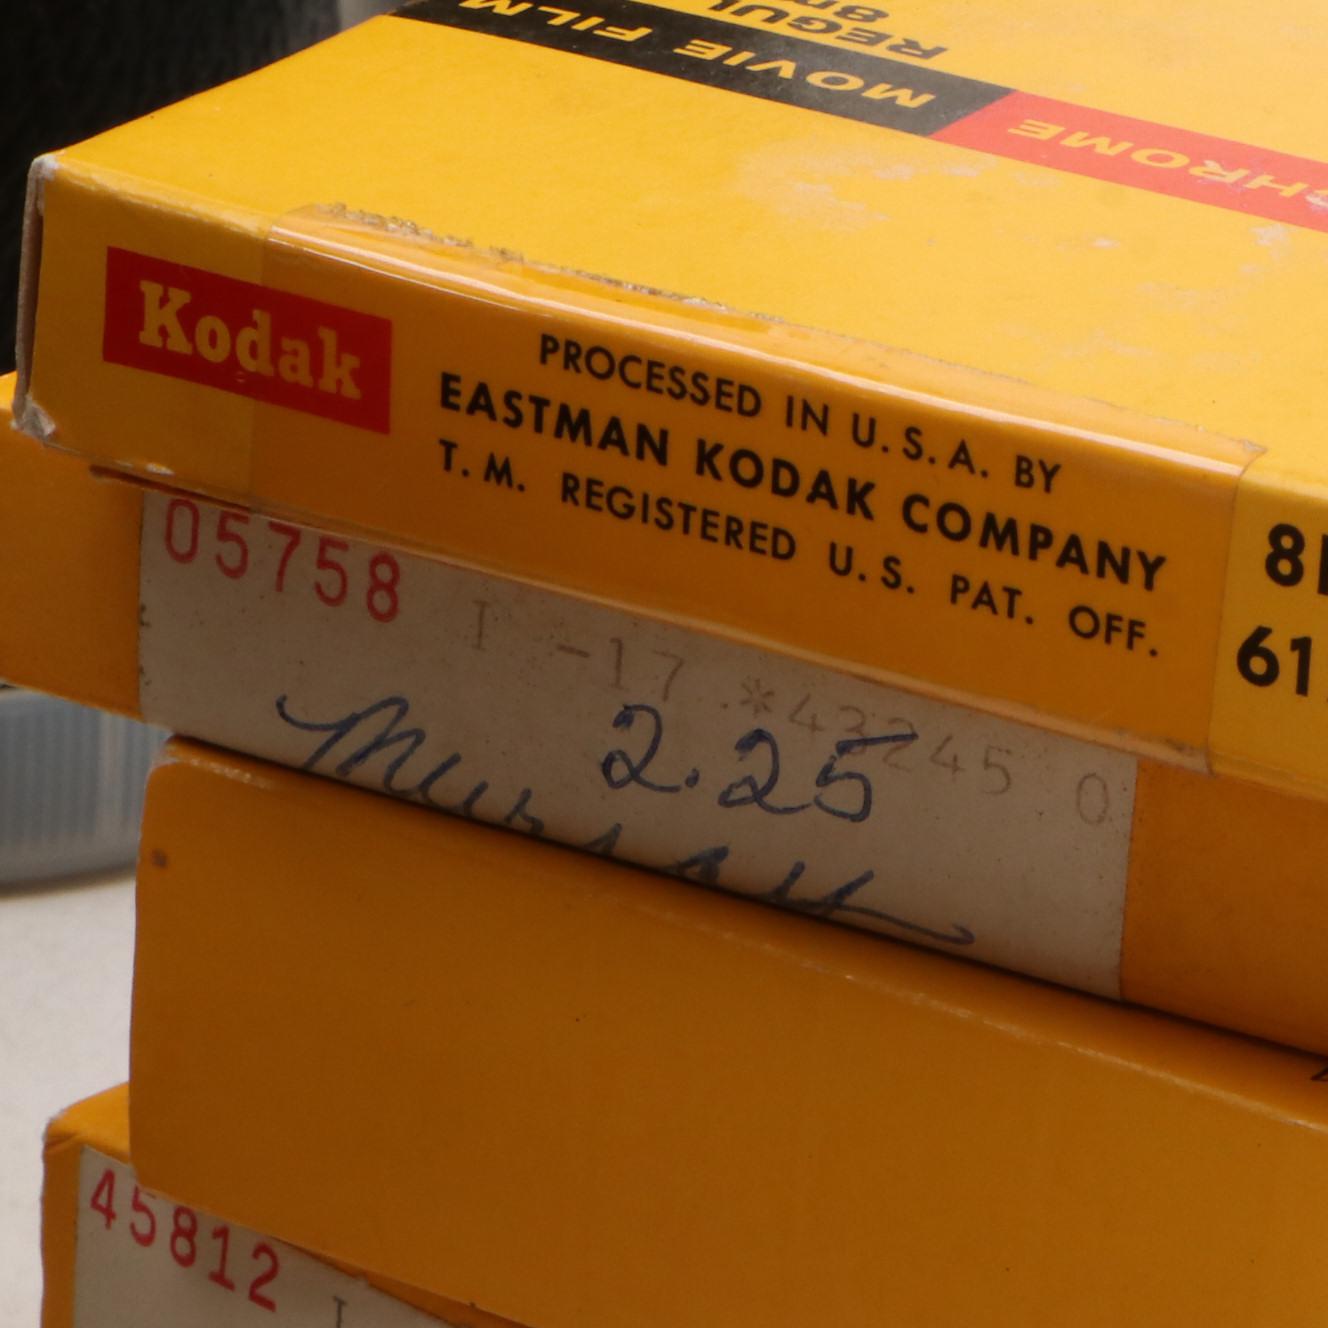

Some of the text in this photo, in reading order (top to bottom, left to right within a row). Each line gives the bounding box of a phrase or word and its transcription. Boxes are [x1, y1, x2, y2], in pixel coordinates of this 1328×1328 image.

[459, 0, 654, 43] FILM
[673, 38, 937, 109] MOVIE
[138, 279, 362, 400] Kodak
[538, 332, 763, 418] PROCESSED
[784, 395, 830, 436] IN
[1014, 455, 1061, 496] BY
[439, 372, 1168, 593] EASTMAN KODAK COMPANY
[163, 499, 403, 624] 05758
[561, 472, 797, 563] REGISTERED
[950, 574, 1035, 626] PAT.
[1069, 605, 1160, 658] OFF.
[600, 704, 919, 823] 2.25
[90, 1168, 280, 1313] 45812
